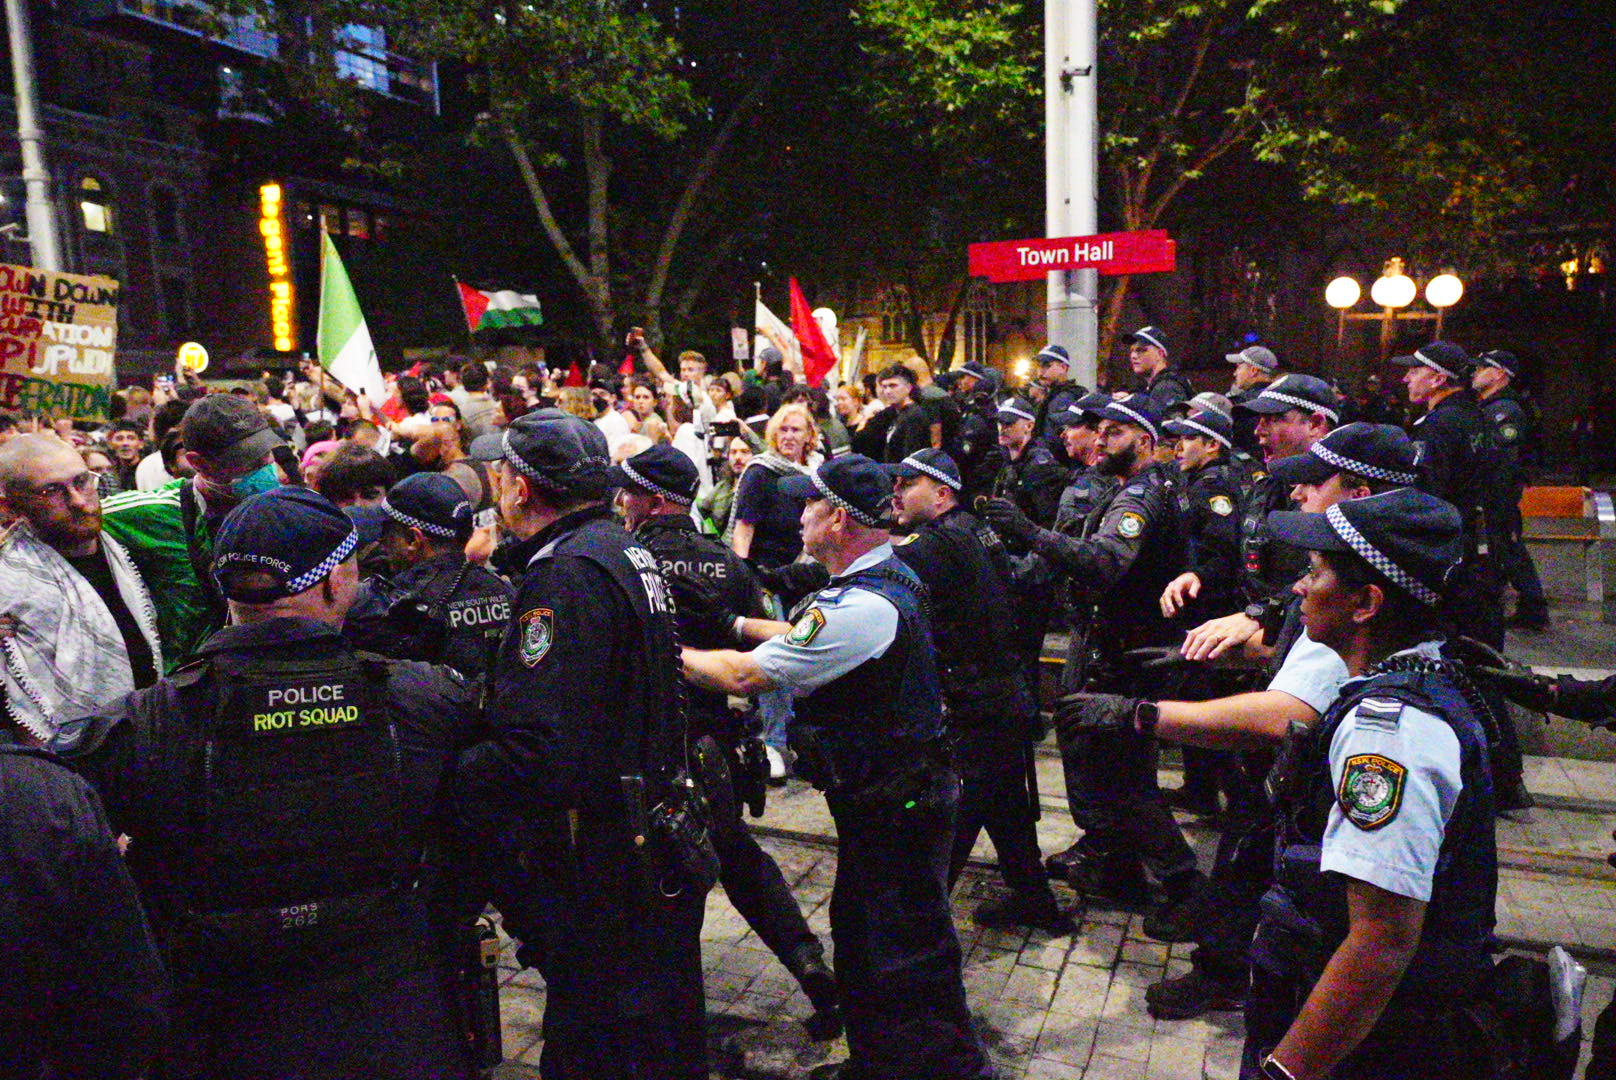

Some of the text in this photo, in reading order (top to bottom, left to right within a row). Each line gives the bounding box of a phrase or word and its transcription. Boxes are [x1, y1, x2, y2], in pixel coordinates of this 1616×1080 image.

[1016, 240, 1114, 266] Town Hall
[54, 278, 118, 307] DOWN
[228, 552, 258, 562] POLICE
[260, 555, 292, 573] FORCE
[661, 560, 727, 578] POLICE
[449, 602, 511, 628] POLICE
[267, 684, 345, 707] POLICE
[253, 705, 359, 731] RIOT SQUAD
